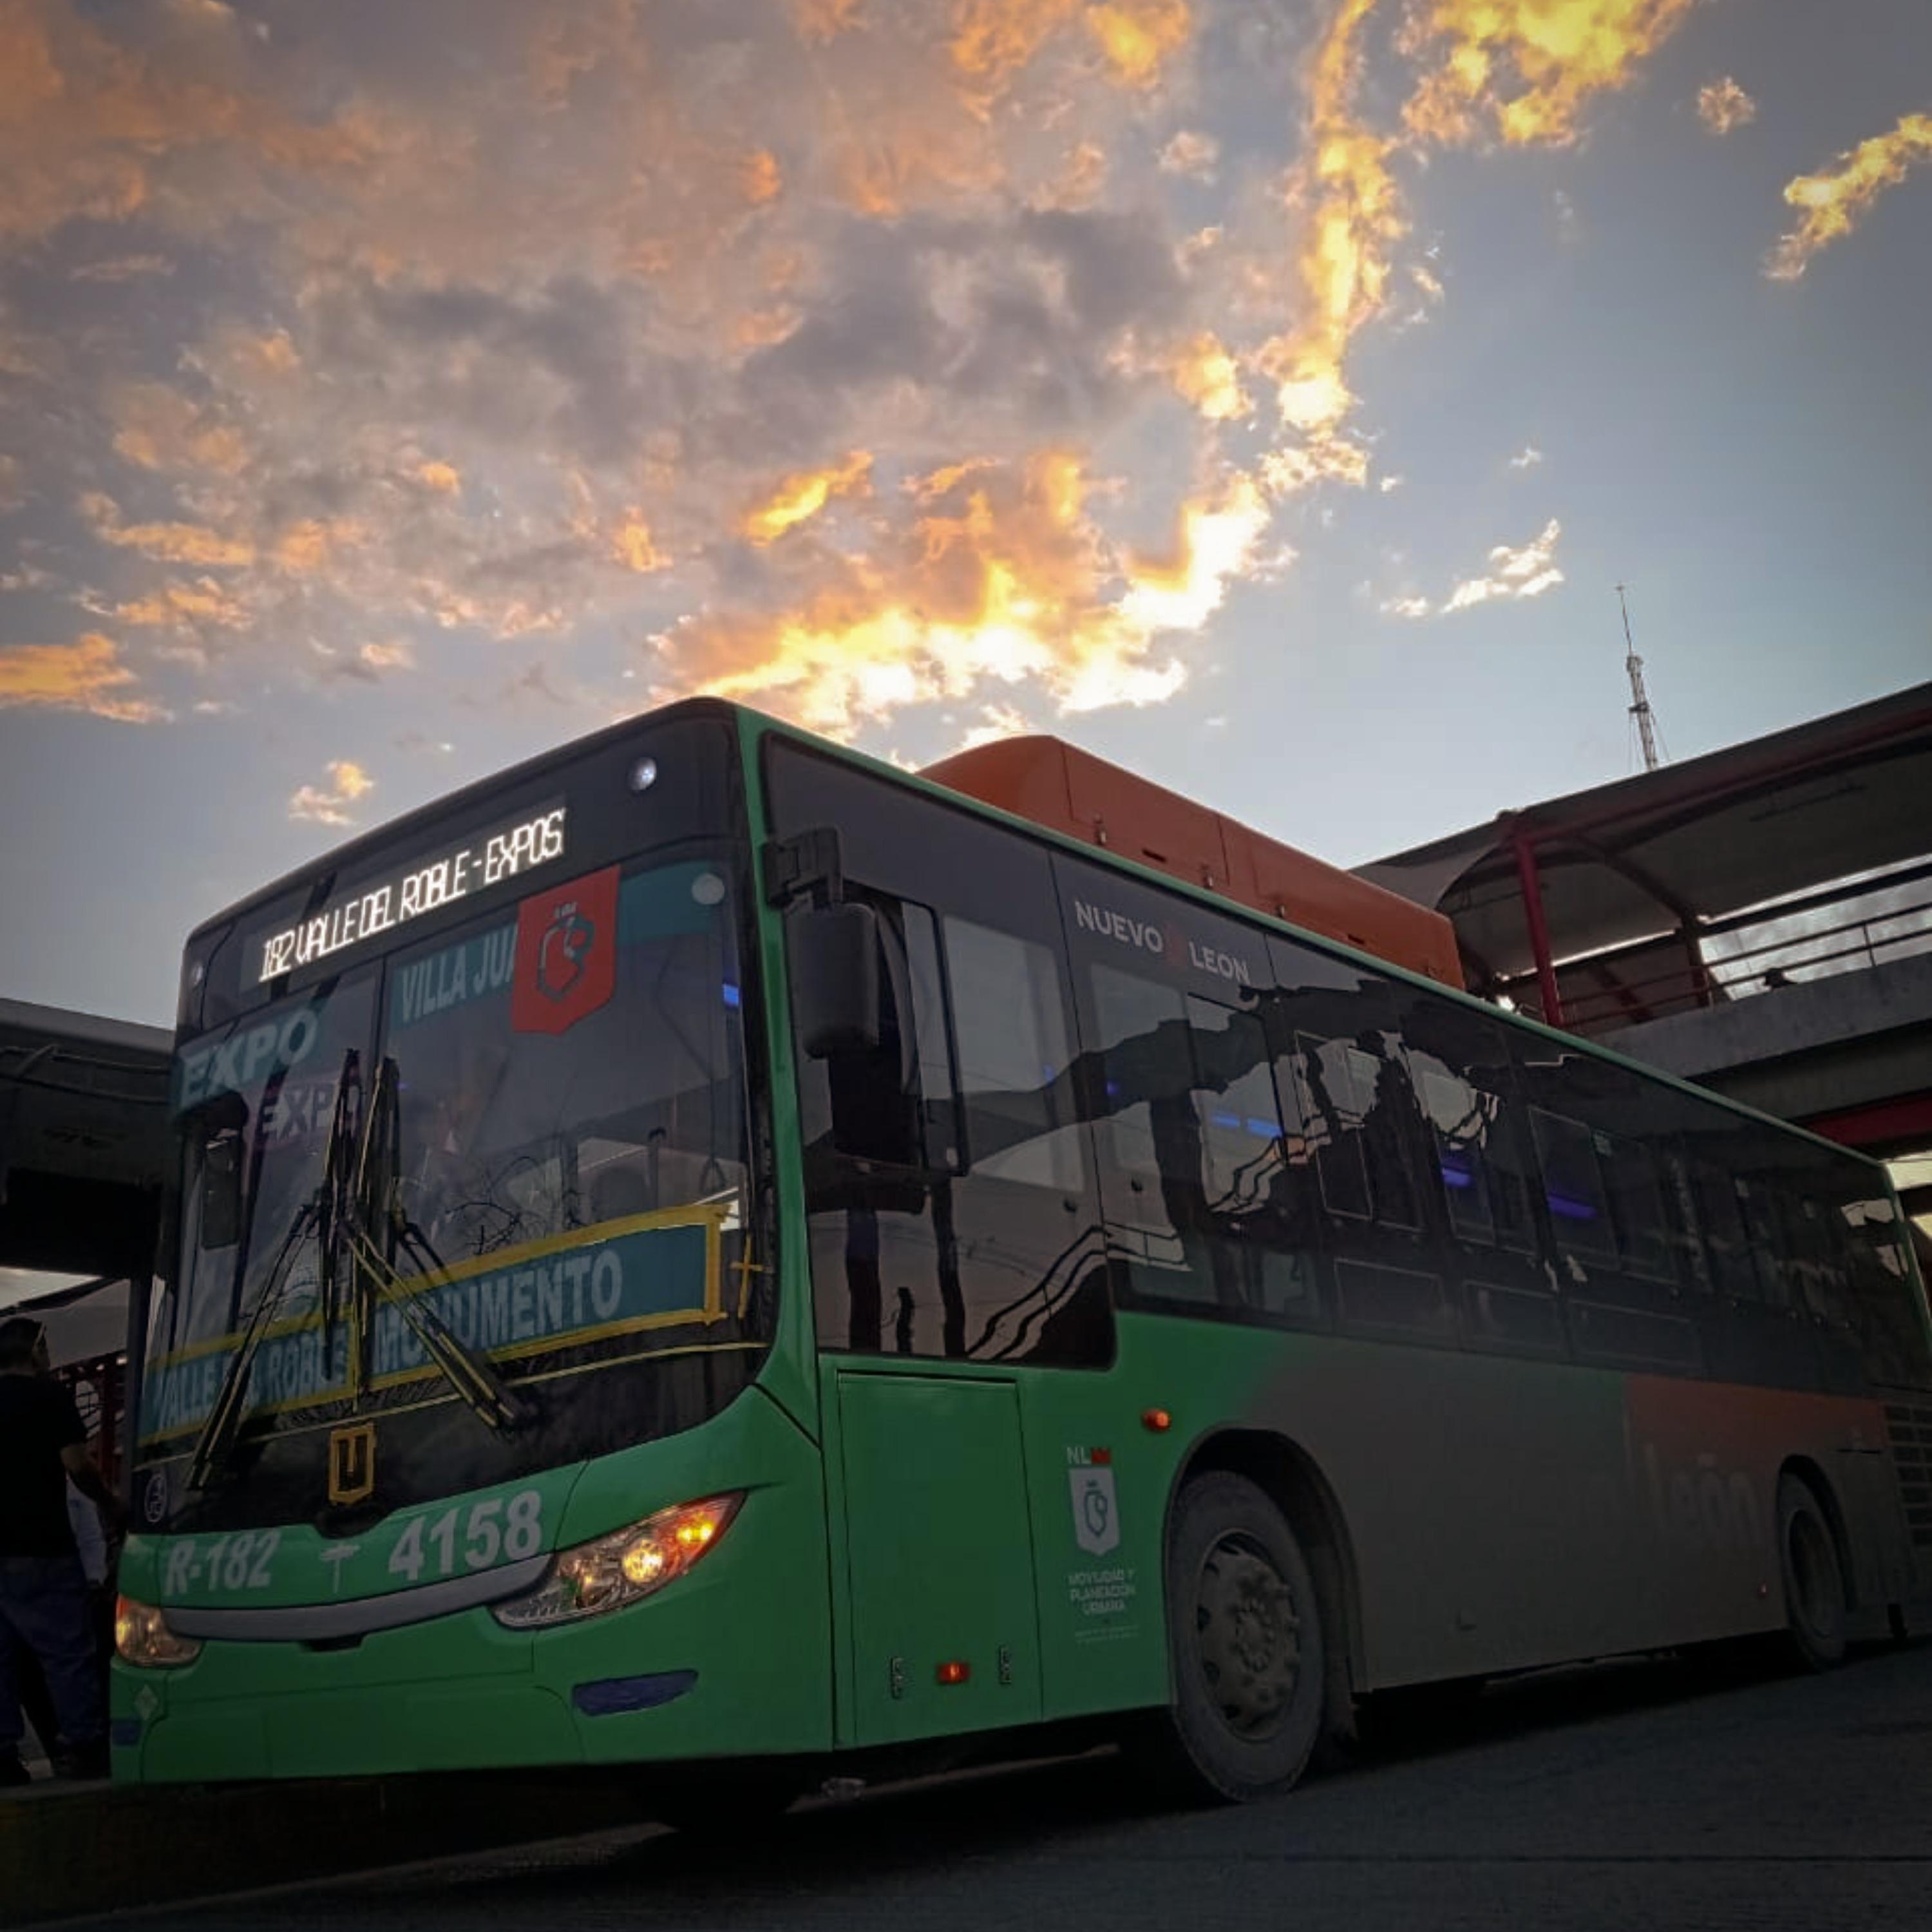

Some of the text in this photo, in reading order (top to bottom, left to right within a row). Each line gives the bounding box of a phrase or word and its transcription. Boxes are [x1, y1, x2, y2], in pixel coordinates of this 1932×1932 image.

[259, 928, 296, 982] 182
[294, 898, 360, 964] VALLE
[357, 885, 397, 938] DEL
[399, 848, 471, 922] ROBLE
[1074, 900, 1164, 953] NUEVO
[402, 942, 468, 1023] VILLA
[178, 1007, 318, 1104] EXPO
[1066, 1446, 1092, 1465] NL
[164, 1526, 281, 1597] R-182
[388, 1490, 542, 1581] 4158
